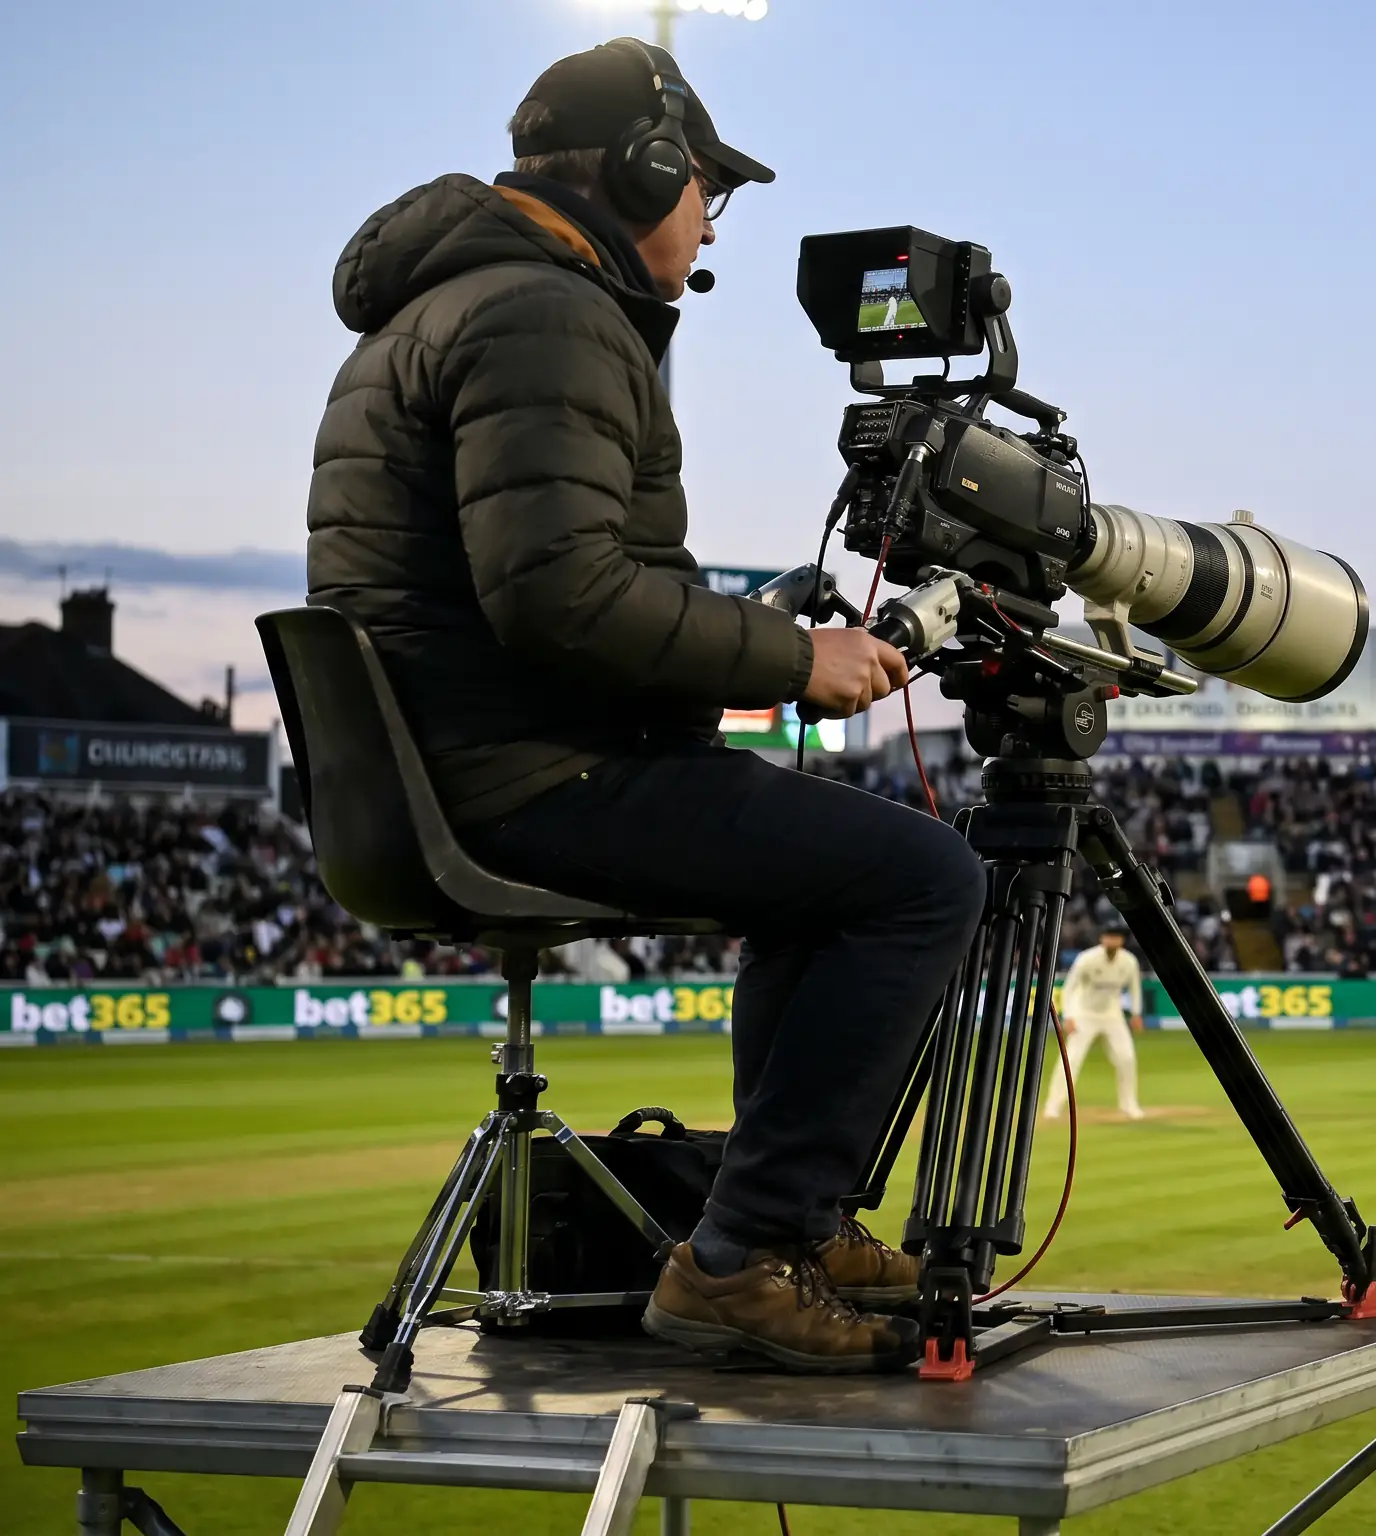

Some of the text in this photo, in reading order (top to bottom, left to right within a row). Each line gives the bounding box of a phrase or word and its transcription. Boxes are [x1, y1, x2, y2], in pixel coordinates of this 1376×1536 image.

[11, 993, 170, 1031] bet365
[295, 989, 447, 1028] bet365
[1219, 985, 1333, 1018] et365
